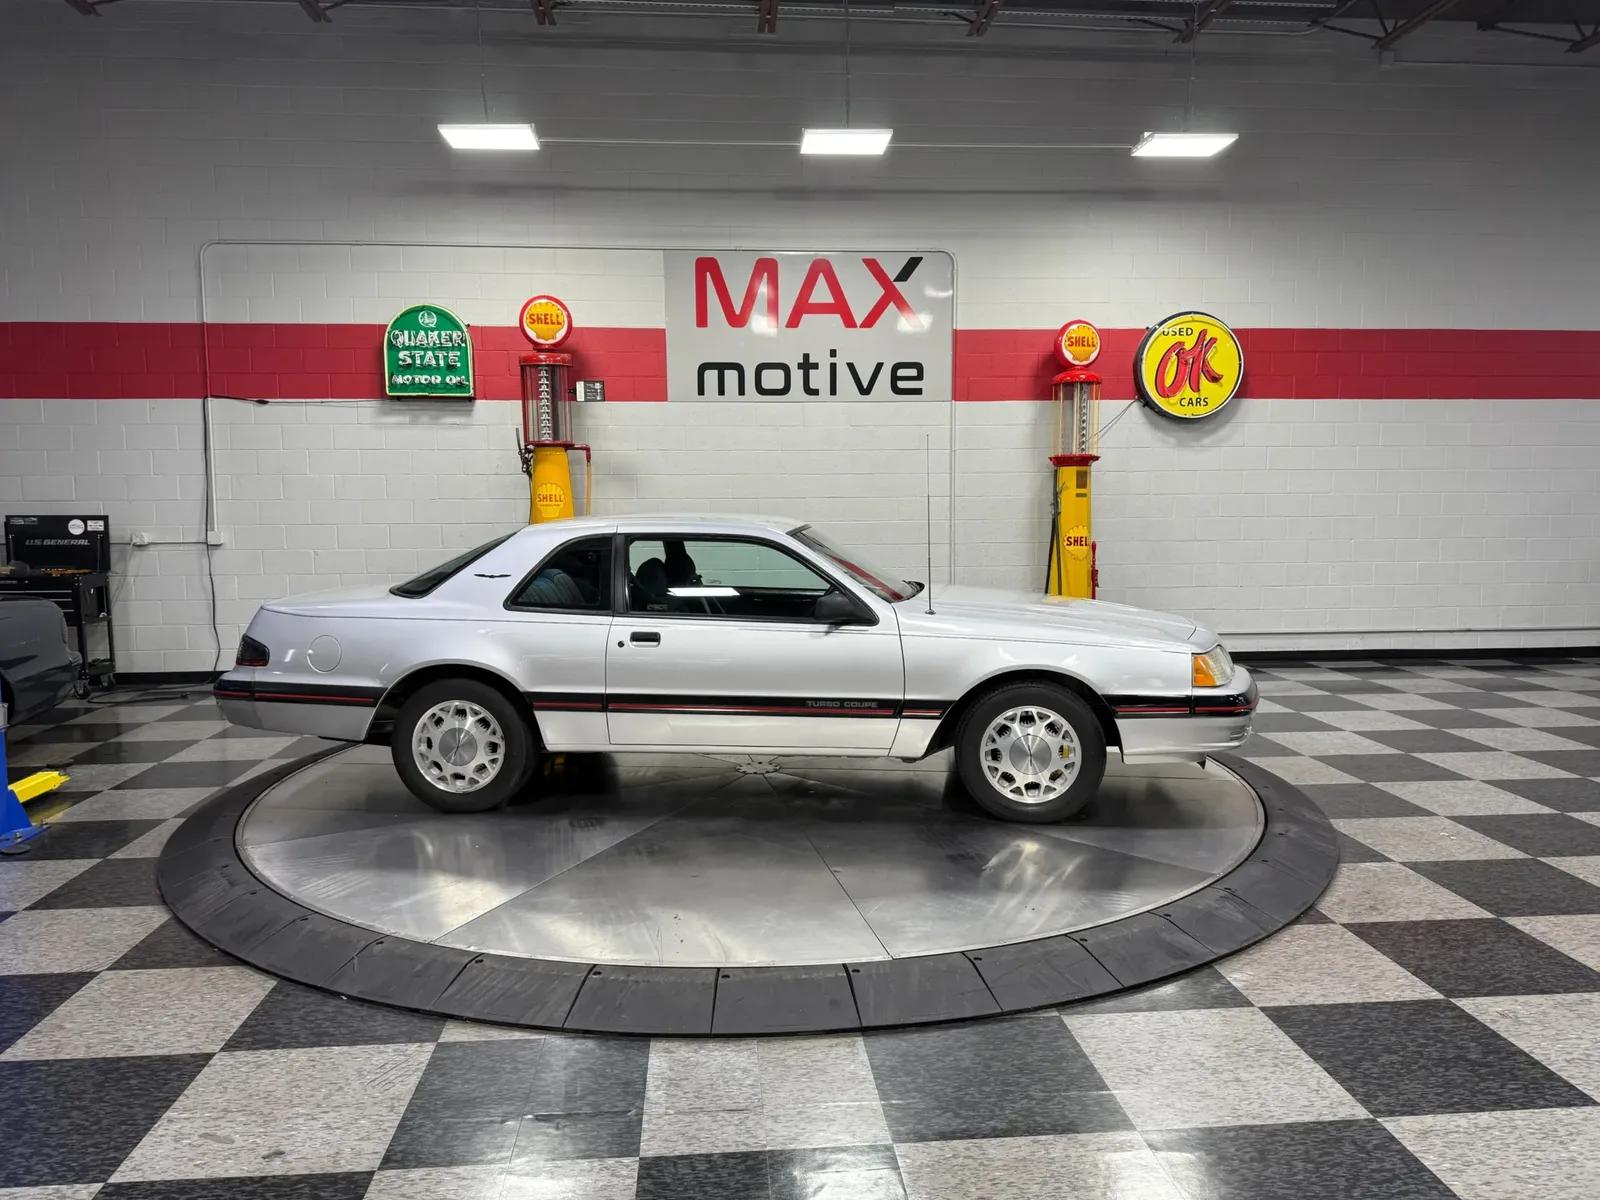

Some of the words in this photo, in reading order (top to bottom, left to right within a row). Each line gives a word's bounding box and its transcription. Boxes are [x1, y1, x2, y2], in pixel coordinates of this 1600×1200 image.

[695, 256, 925, 329] MAX
[528, 313, 562, 326] SHELL
[1162, 327, 1194, 337] USED
[390, 329, 466, 349] QUAKER
[1067, 336, 1096, 347] SHELL
[398, 350, 461, 367] STATE
[697, 348, 924, 396] motive
[391, 374, 442, 385] MOTOR
[1179, 397, 1209, 407] CARS
[537, 493, 564, 503] SHELL
[1066, 536, 1090, 547] SHEL
[806, 700, 840, 708] TURBO
